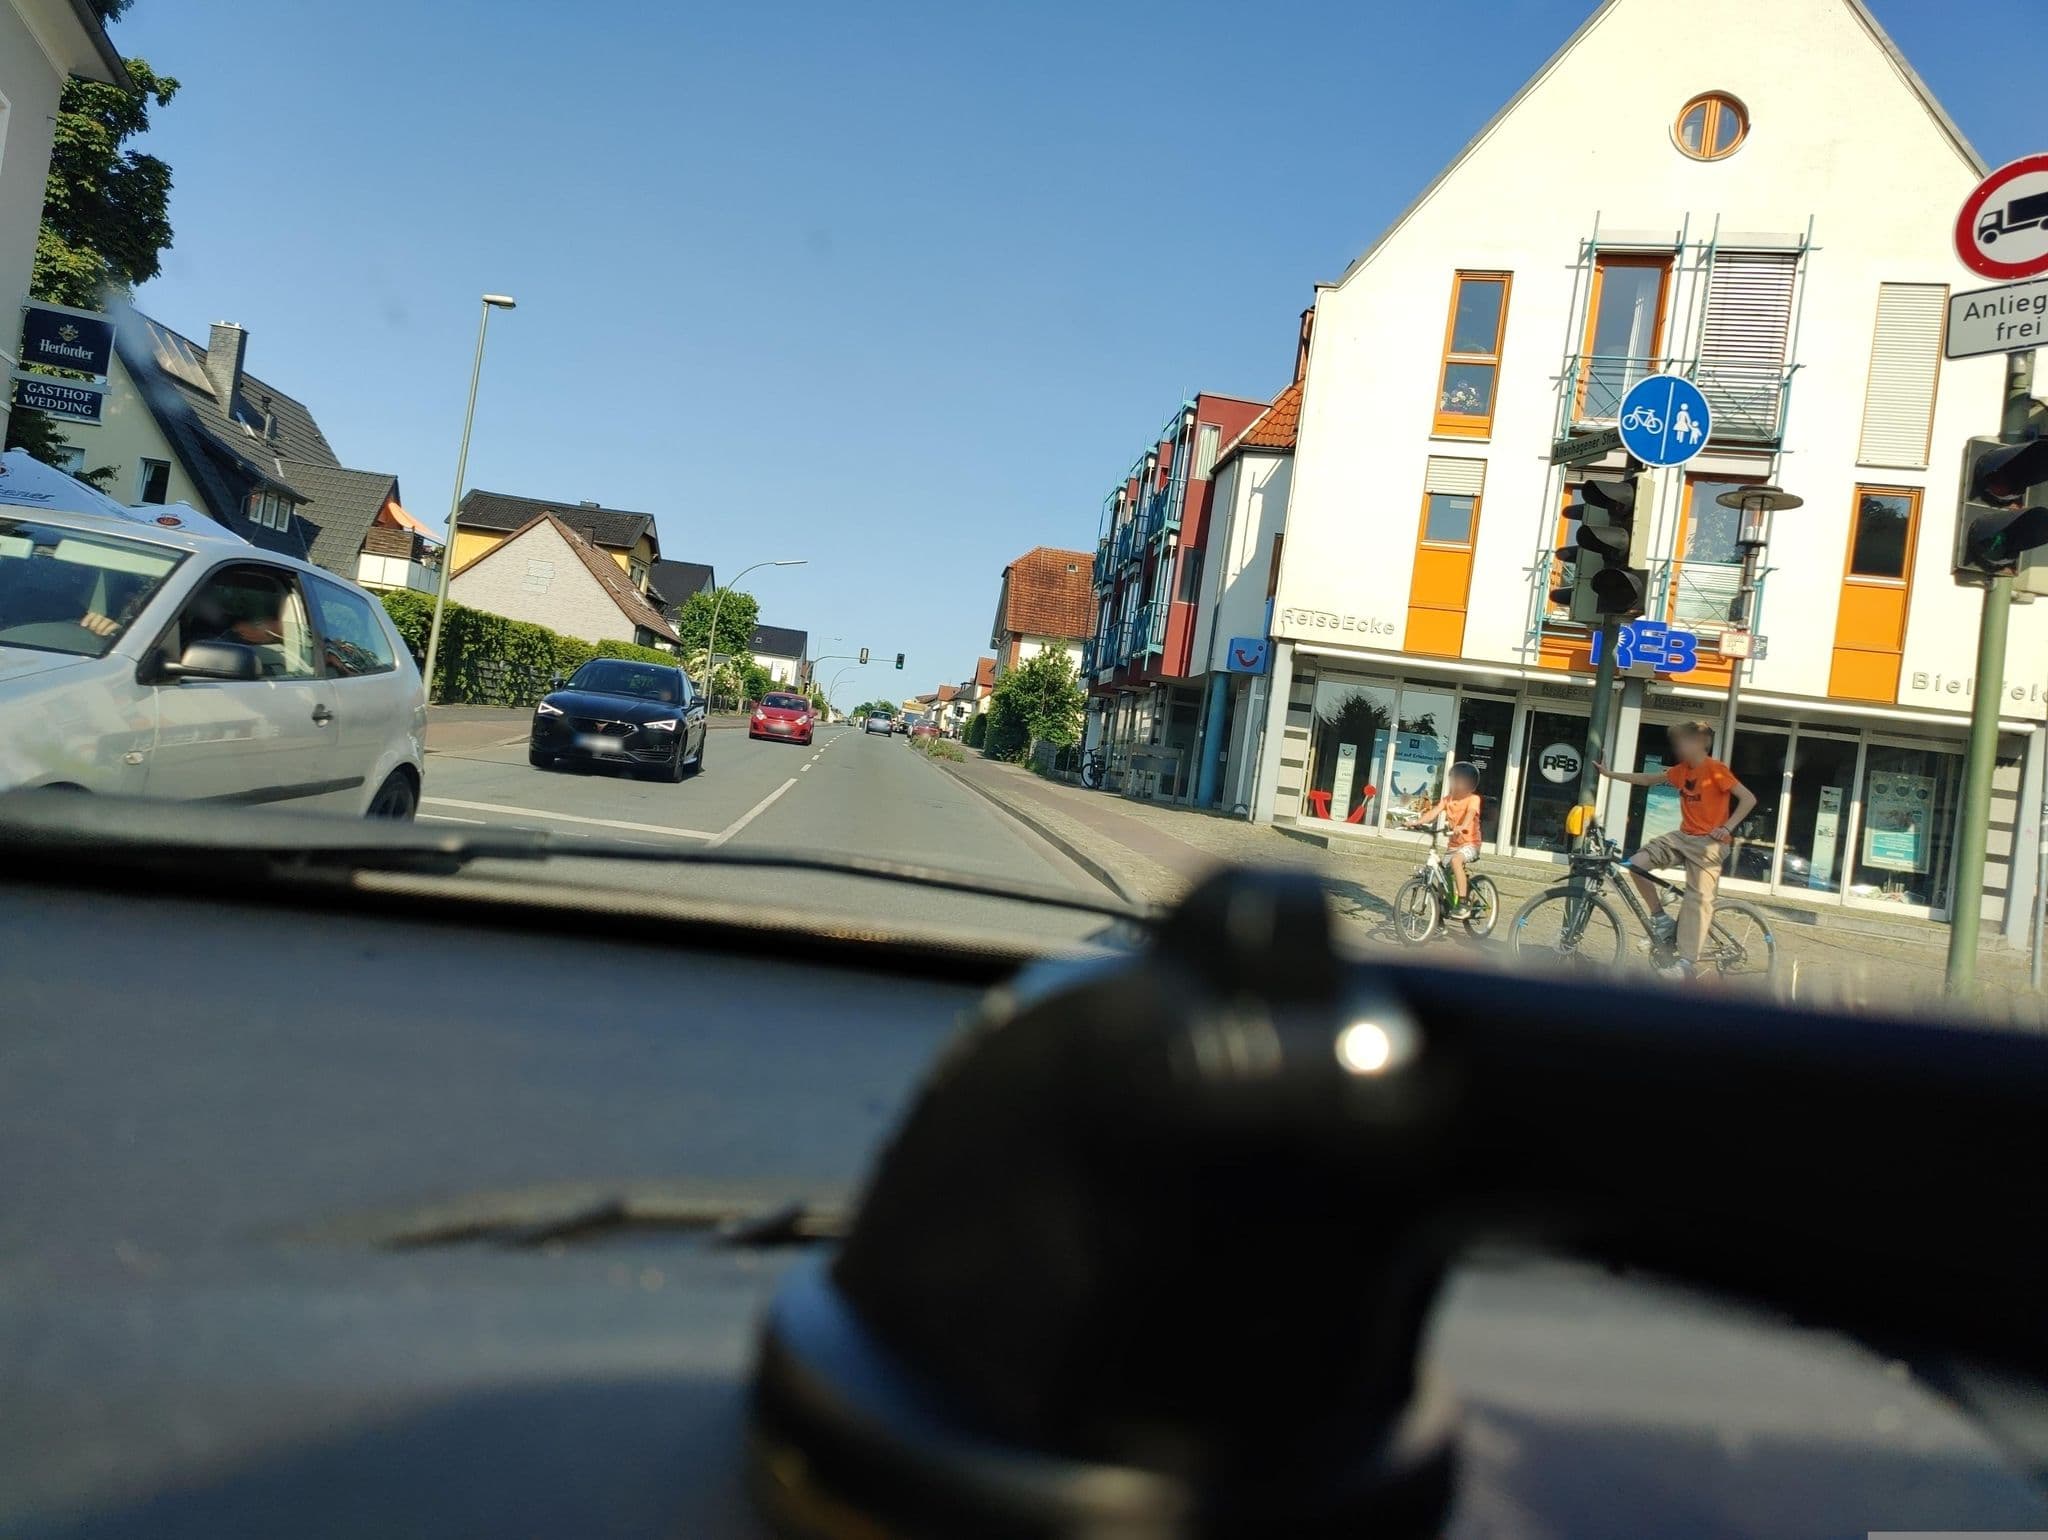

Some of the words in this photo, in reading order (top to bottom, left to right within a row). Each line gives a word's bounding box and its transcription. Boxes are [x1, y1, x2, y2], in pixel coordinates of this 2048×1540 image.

[1996, 316, 2041, 341] frei
[40, 339, 94, 360] Herforder
[27, 383, 92, 402] GASTHOF
[24, 395, 92, 415] WEDDING
[1281, 608, 1395, 635] ReiseEcke
[1589, 620, 1698, 673] REB
[1543, 755, 1578, 772] REB
